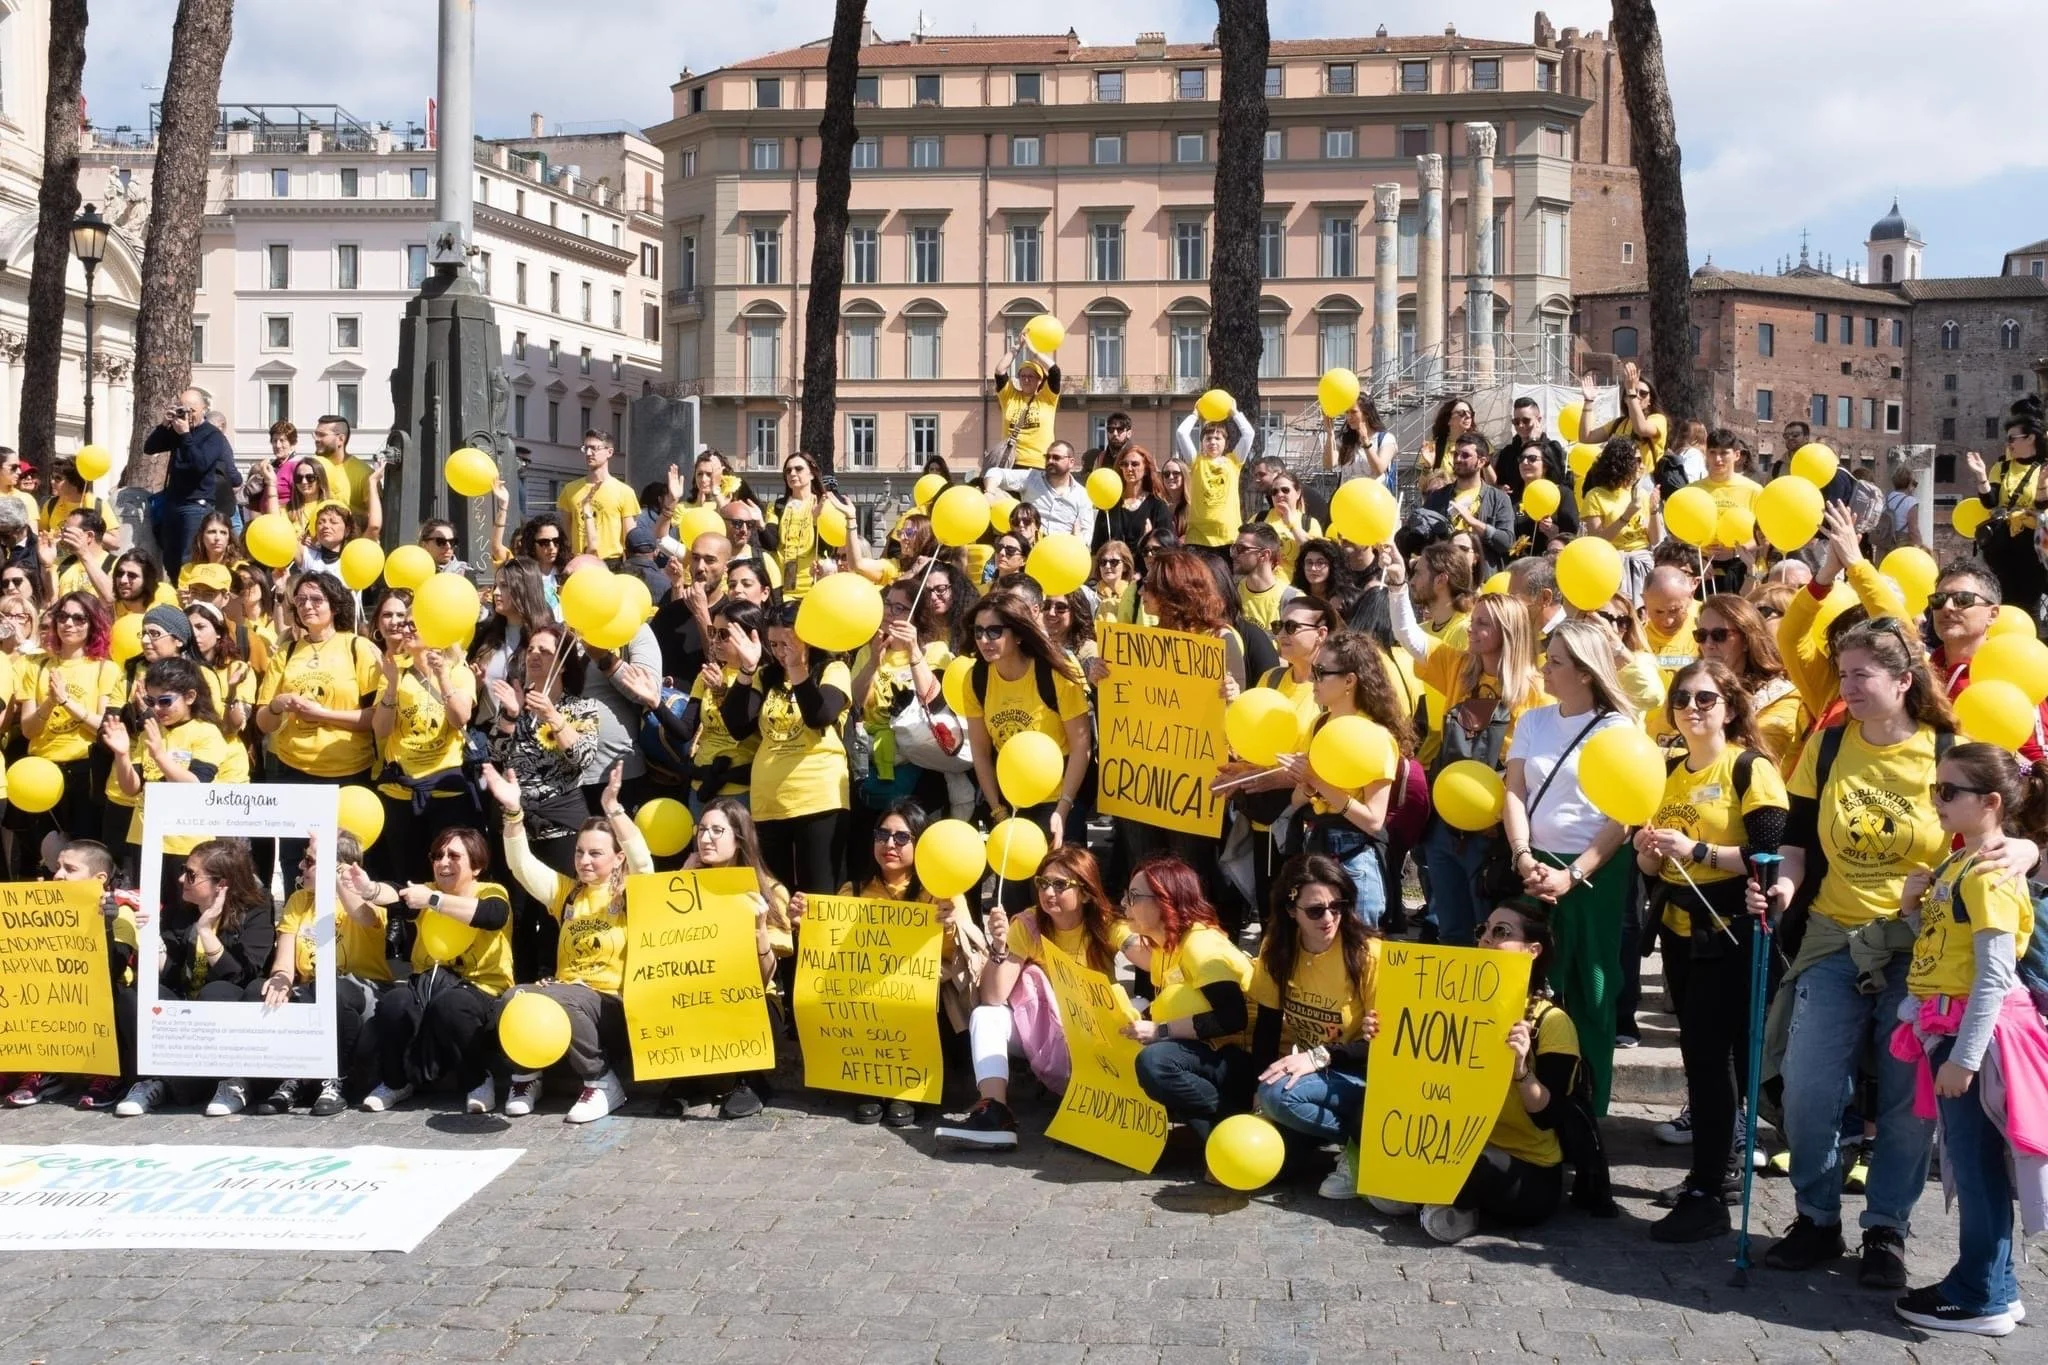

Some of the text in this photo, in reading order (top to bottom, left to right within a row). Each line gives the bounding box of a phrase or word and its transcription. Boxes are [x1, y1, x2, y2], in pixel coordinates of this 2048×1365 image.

[1101, 628, 1225, 681] L'ENDOMETRIOSI
[1144, 686, 1180, 709] UNA
[1110, 716, 1215, 760] MALATTIA
[1102, 758, 1218, 819] CRONICA!
[205, 789, 278, 815] Instagram
[1839, 789, 1914, 814] WORLDWIDE
[1844, 796, 1906, 817] ENDOMARCH
[3, 888, 64, 906] IN MEDIA
[2, 910, 79, 929] DIAGNOSI
[640, 923, 719, 948] AL CONGEDO
[855, 928, 891, 947] UNA
[2, 957, 89, 975] ARRIVA DOPO
[633, 958, 716, 982] MESTRUALE
[801, 947, 937, 981] MALATTIA SOCIALE
[813, 976, 917, 1001] CHE RIGUARDA
[1387, 950, 1500, 1003] UN FIGLIO
[47, 982, 89, 1006] ANNI
[672, 985, 764, 1009] NELLE SCUOLE
[93, 1022, 110, 1038] DEI
[640, 1024, 675, 1040] E SUI
[819, 1026, 907, 1043] NON SOLO
[1393, 1007, 1469, 1066] NON
[37, 1042, 96, 1058] SINTOMI!
[647, 1031, 768, 1066] POSTI DI LAVORO!
[842, 1046, 864, 1057] CHI
[875, 1047, 896, 1059] NE
[1421, 1081, 1451, 1103] UNA
[1067, 1083, 1167, 1143] L'ENDOMETRIOSI
[1381, 1109, 1487, 1165] CURA!!!
[41, 1169, 226, 1190] ENDO
[213, 1176, 387, 1192] METRIOSIS
[107, 1190, 369, 1215] MARCH
[42, 1228, 114, 1240] della
